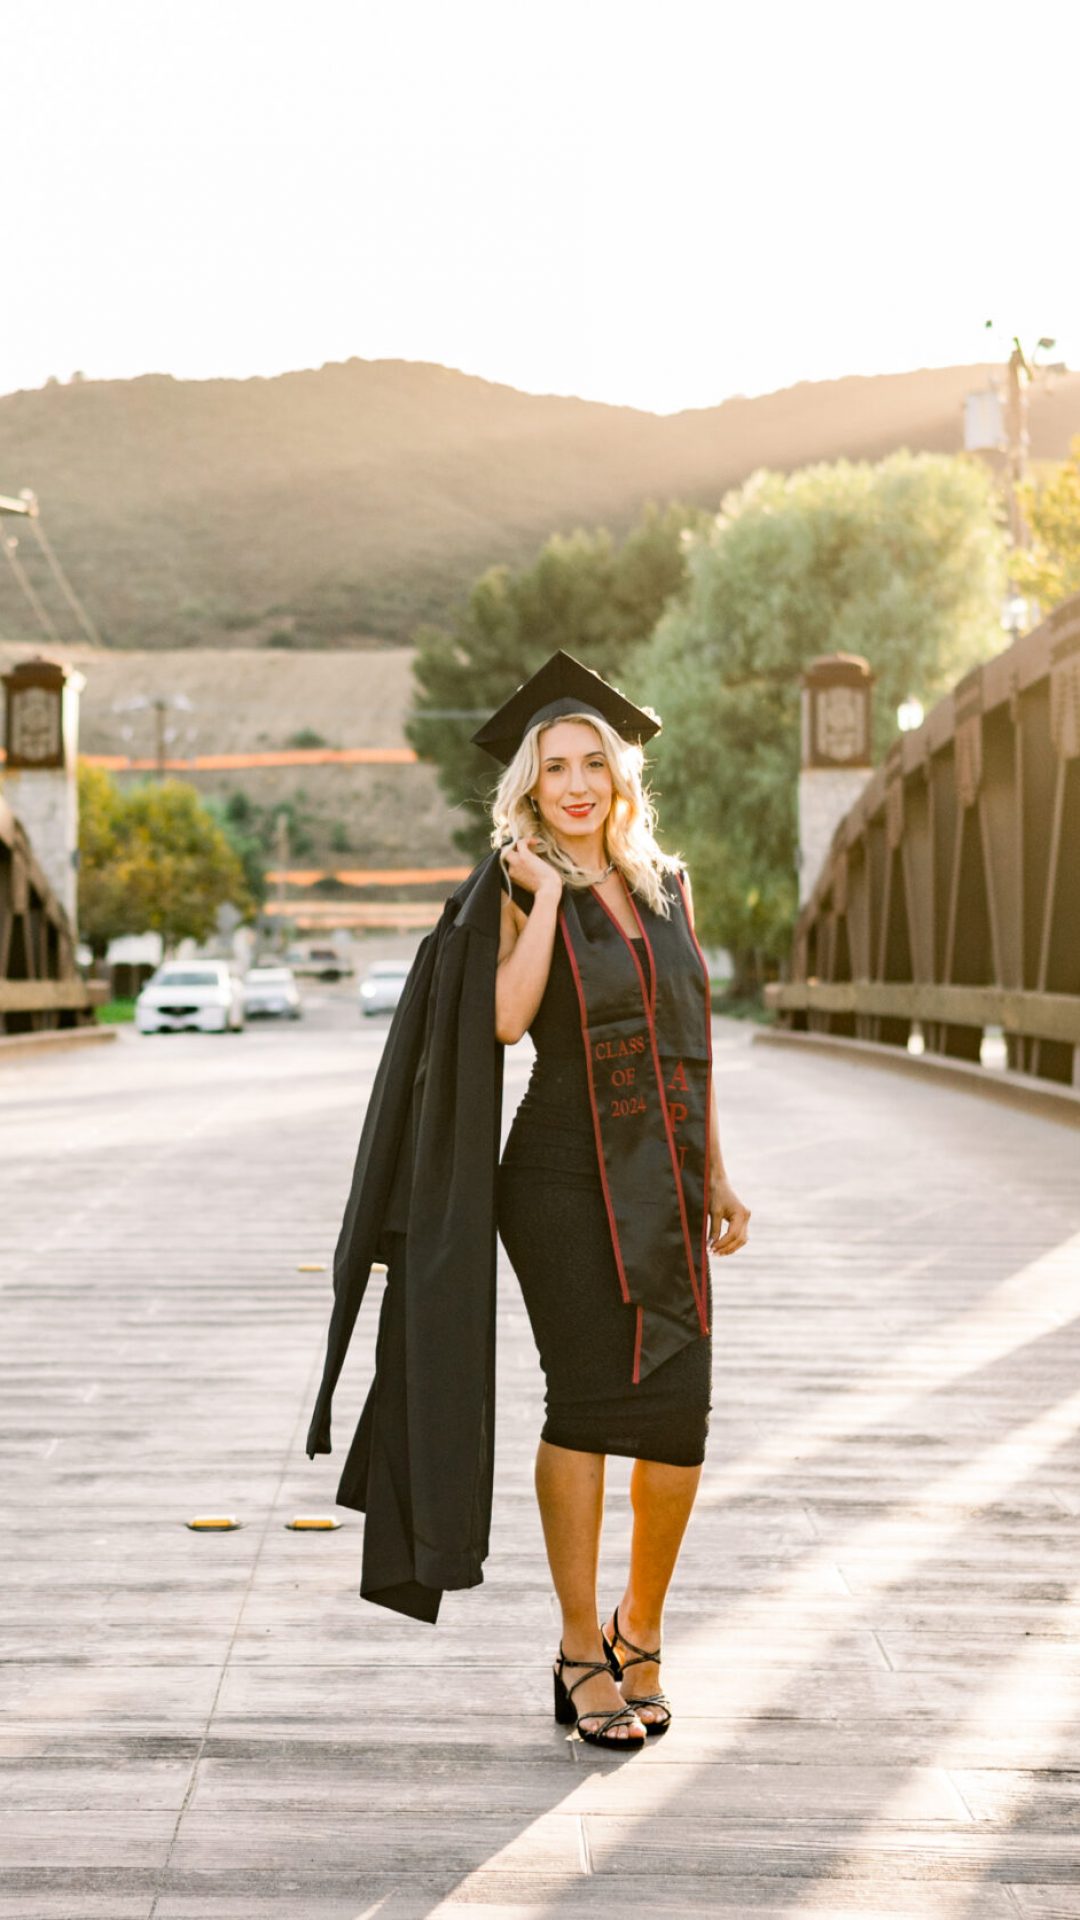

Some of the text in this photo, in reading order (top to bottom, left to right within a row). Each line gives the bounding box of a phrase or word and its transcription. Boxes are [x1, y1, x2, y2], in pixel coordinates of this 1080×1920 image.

[595, 1036, 646, 1060] CLASS
[611, 1068, 636, 1087] OF
[611, 1096, 647, 1118] 2024
